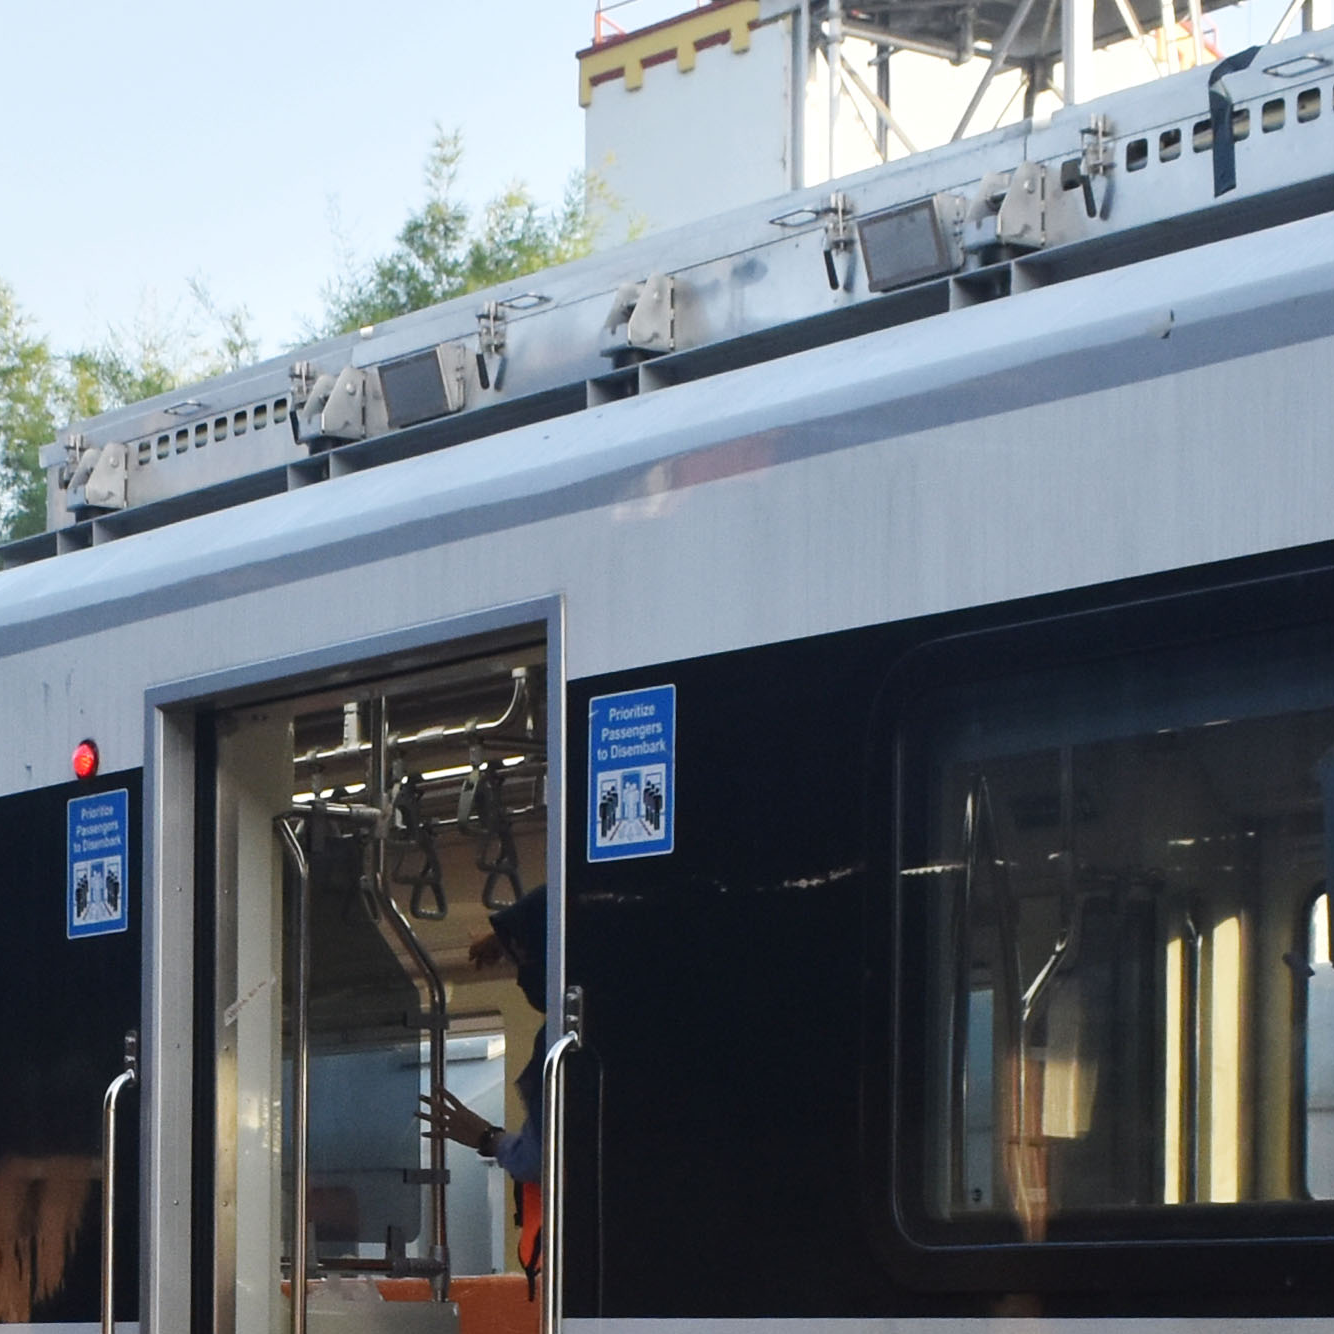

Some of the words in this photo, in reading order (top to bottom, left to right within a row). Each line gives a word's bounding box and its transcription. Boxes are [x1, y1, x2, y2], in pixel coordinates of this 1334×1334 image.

[609, 704, 655, 721] Prioritize
[601, 722, 663, 742] Passengers
[597, 747, 608, 761] to
[610, 739, 666, 759] Disembark
[81, 805, 114, 821] Prioritize
[75, 820, 119, 837] Passengers
[73, 842, 81, 853] to
[82, 836, 121, 852] Disembark
